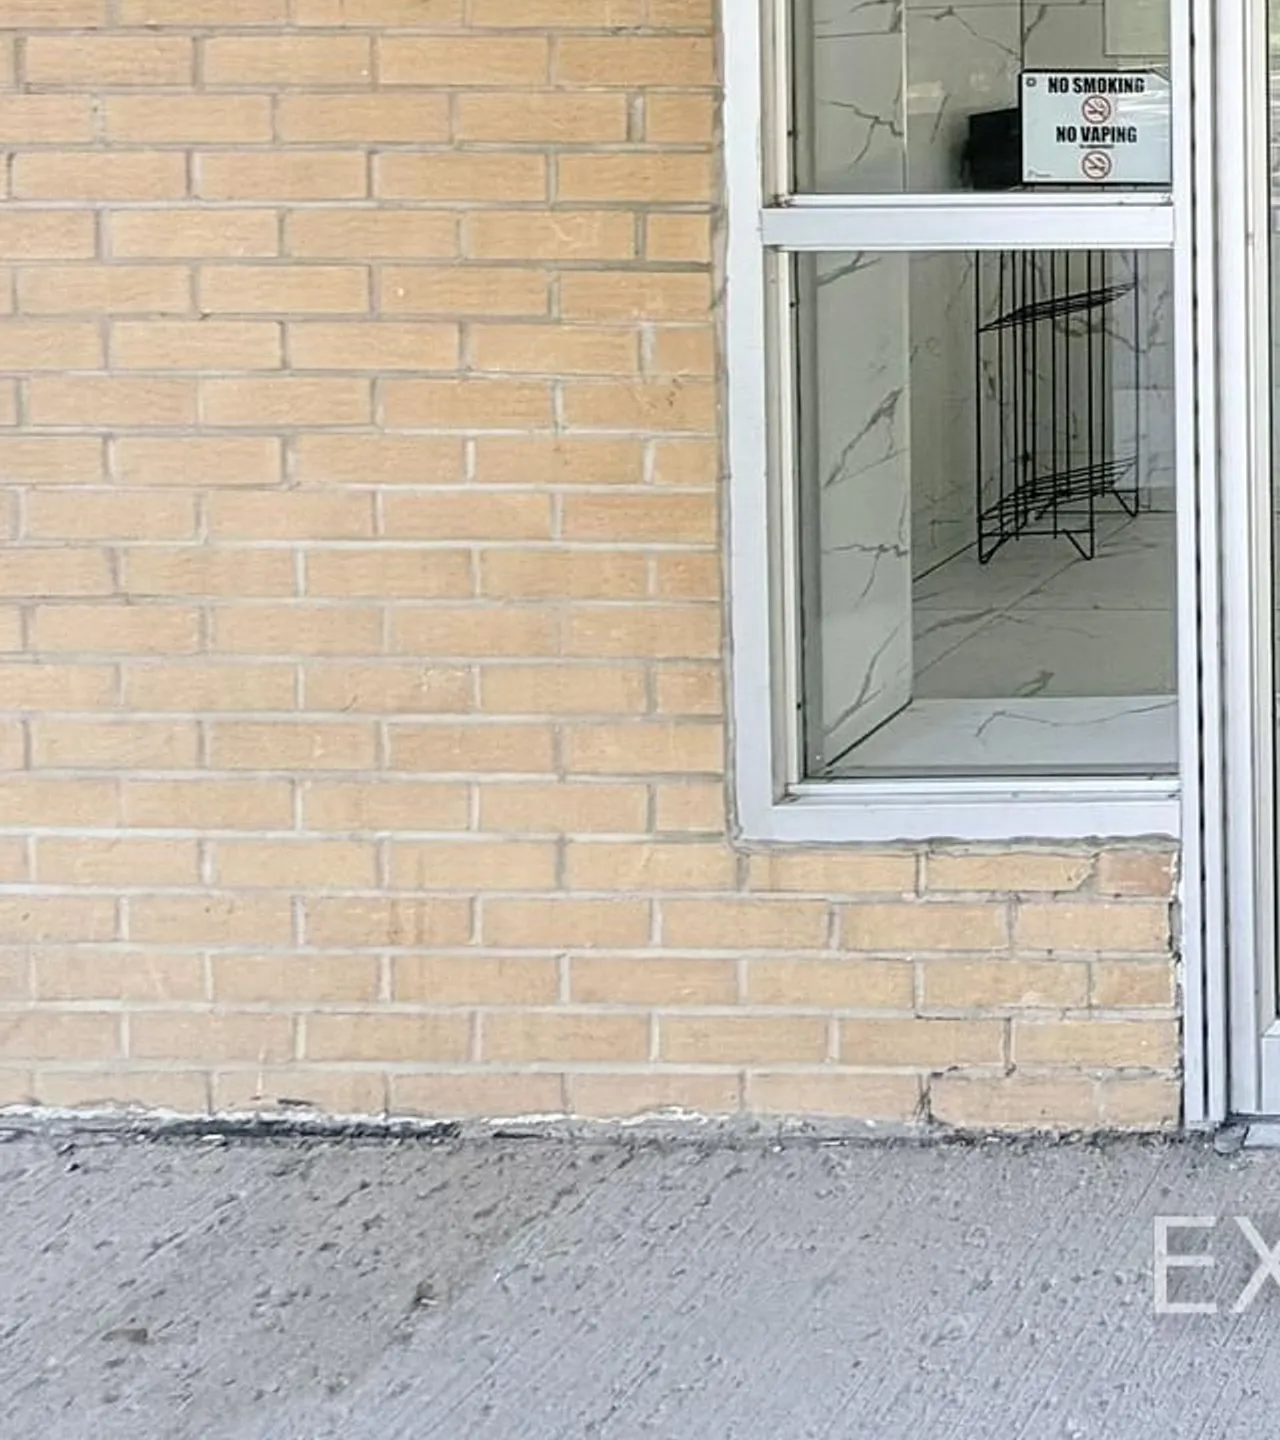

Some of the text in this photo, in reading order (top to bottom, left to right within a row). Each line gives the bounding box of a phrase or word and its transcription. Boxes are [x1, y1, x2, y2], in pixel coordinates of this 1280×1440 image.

[1048, 77, 1145, 93] NO SMOKING
[1056, 126, 1137, 143] NO VAPING
